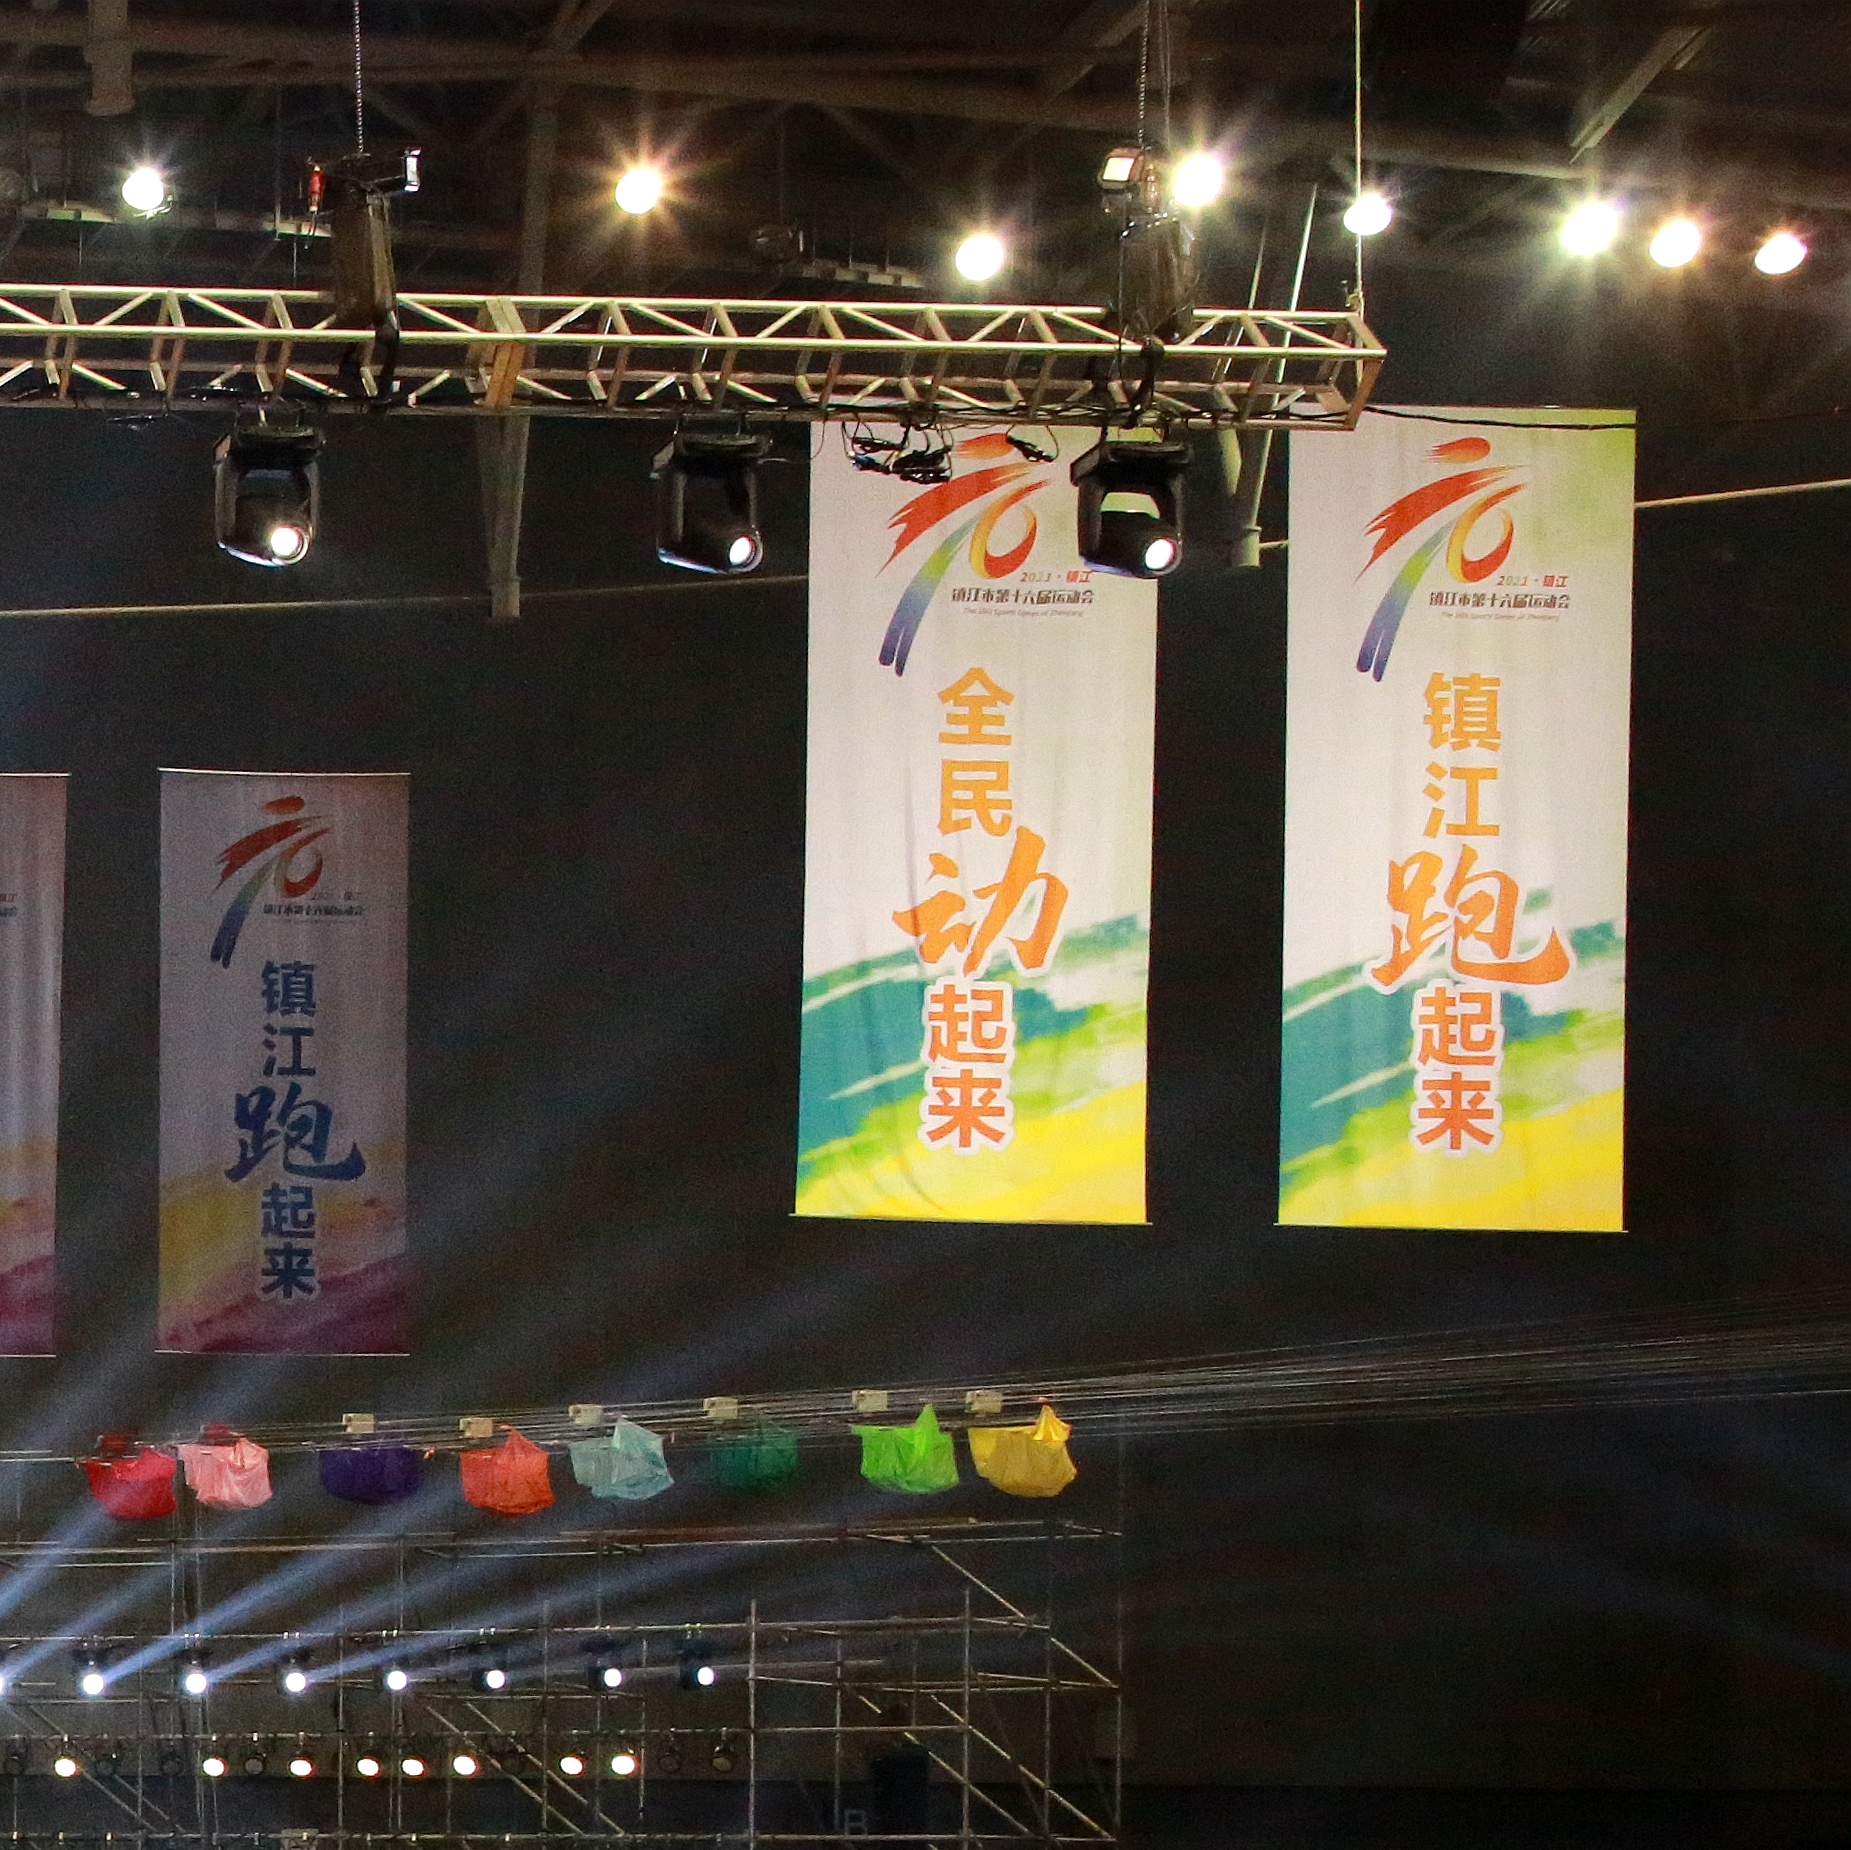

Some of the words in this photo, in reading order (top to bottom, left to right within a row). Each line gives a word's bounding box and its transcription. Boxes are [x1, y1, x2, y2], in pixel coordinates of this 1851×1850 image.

[226, 960, 366, 1299] 镇江跑起来
[894, 668, 1070, 1149] 全民动起来
[1373, 672, 1572, 1152] 镇江跑起来
